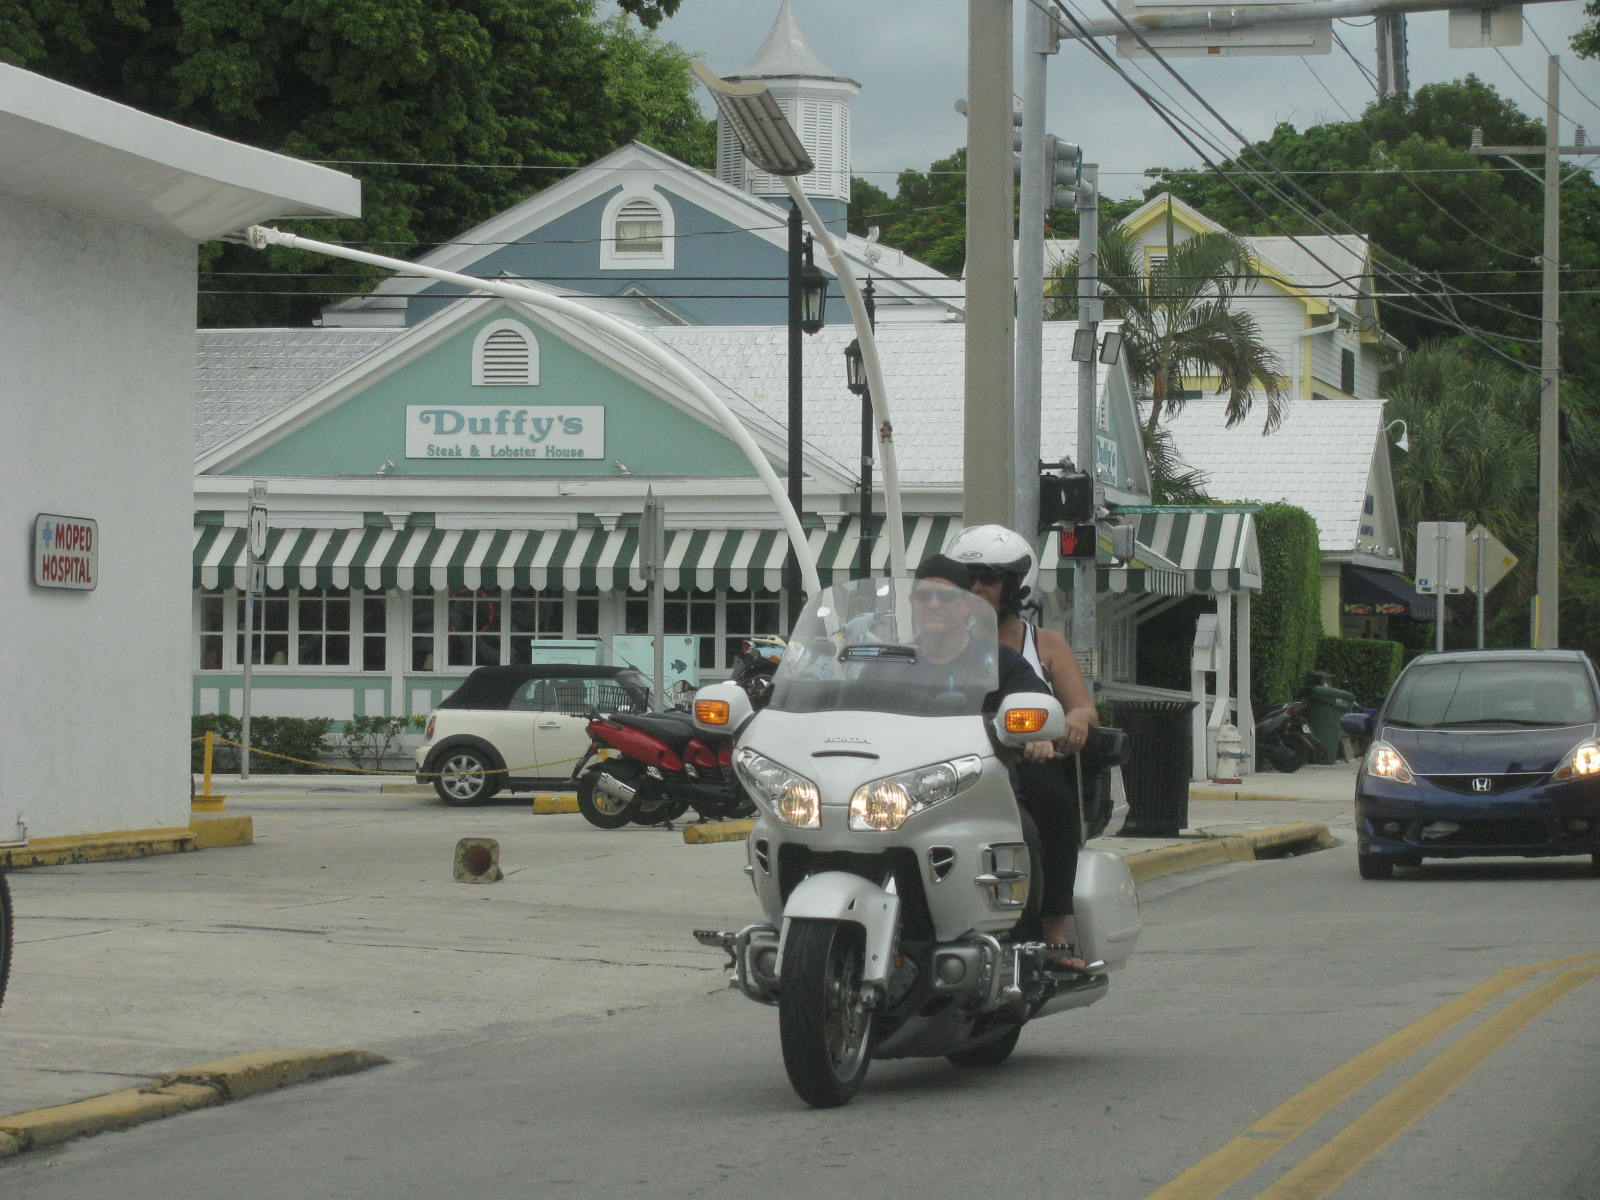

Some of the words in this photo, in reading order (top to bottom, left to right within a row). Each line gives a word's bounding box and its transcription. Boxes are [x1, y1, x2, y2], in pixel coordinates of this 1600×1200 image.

[419, 410, 584, 443] Duffy's
[427, 444, 462, 458] Steak
[470, 444, 480, 458] &
[491, 444, 537, 458] Lobster
[545, 445, 585, 459] House
[55, 523, 92, 552] MOPED
[42, 554, 92, 584] HOSPITAL
